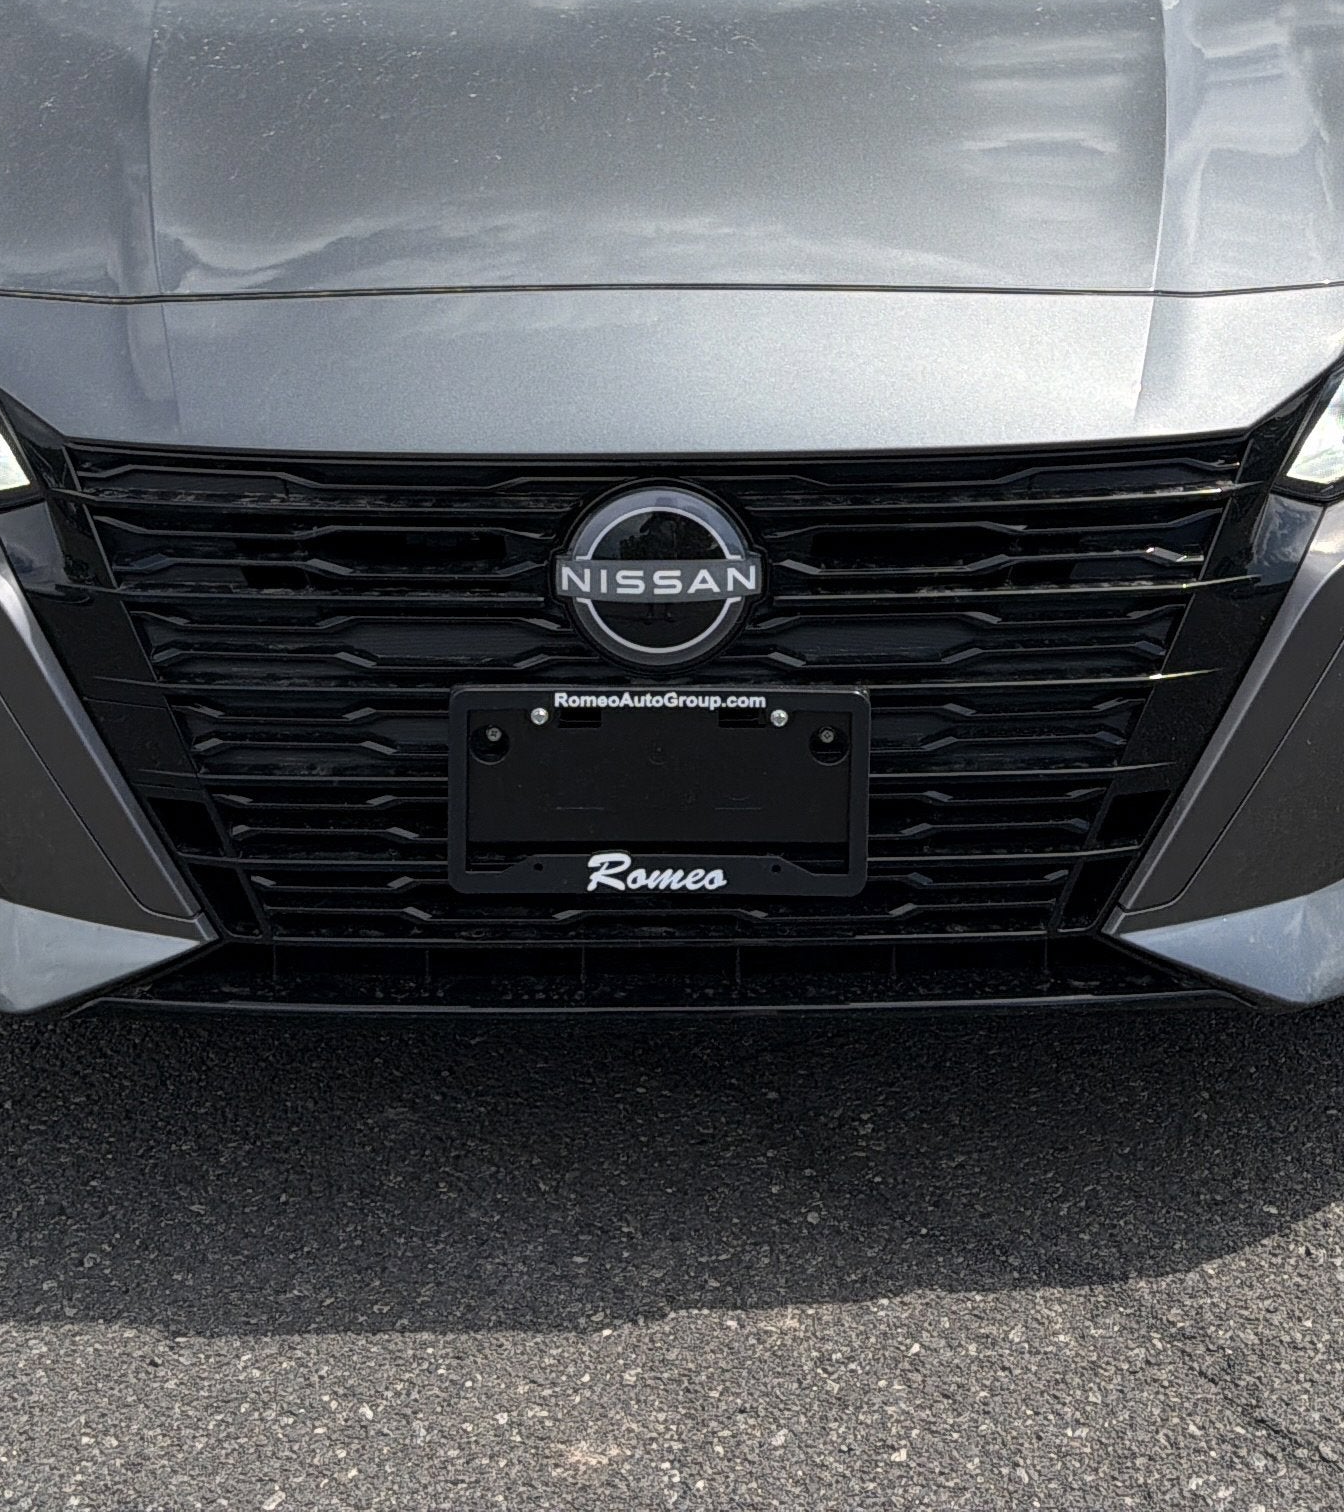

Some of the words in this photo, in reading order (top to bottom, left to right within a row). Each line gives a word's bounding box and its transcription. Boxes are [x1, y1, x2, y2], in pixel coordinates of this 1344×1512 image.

[561, 565, 756, 595] NISSAN
[554, 692, 767, 710] RomeoAutoGroup.com
[587, 852, 727, 892] Romeo
